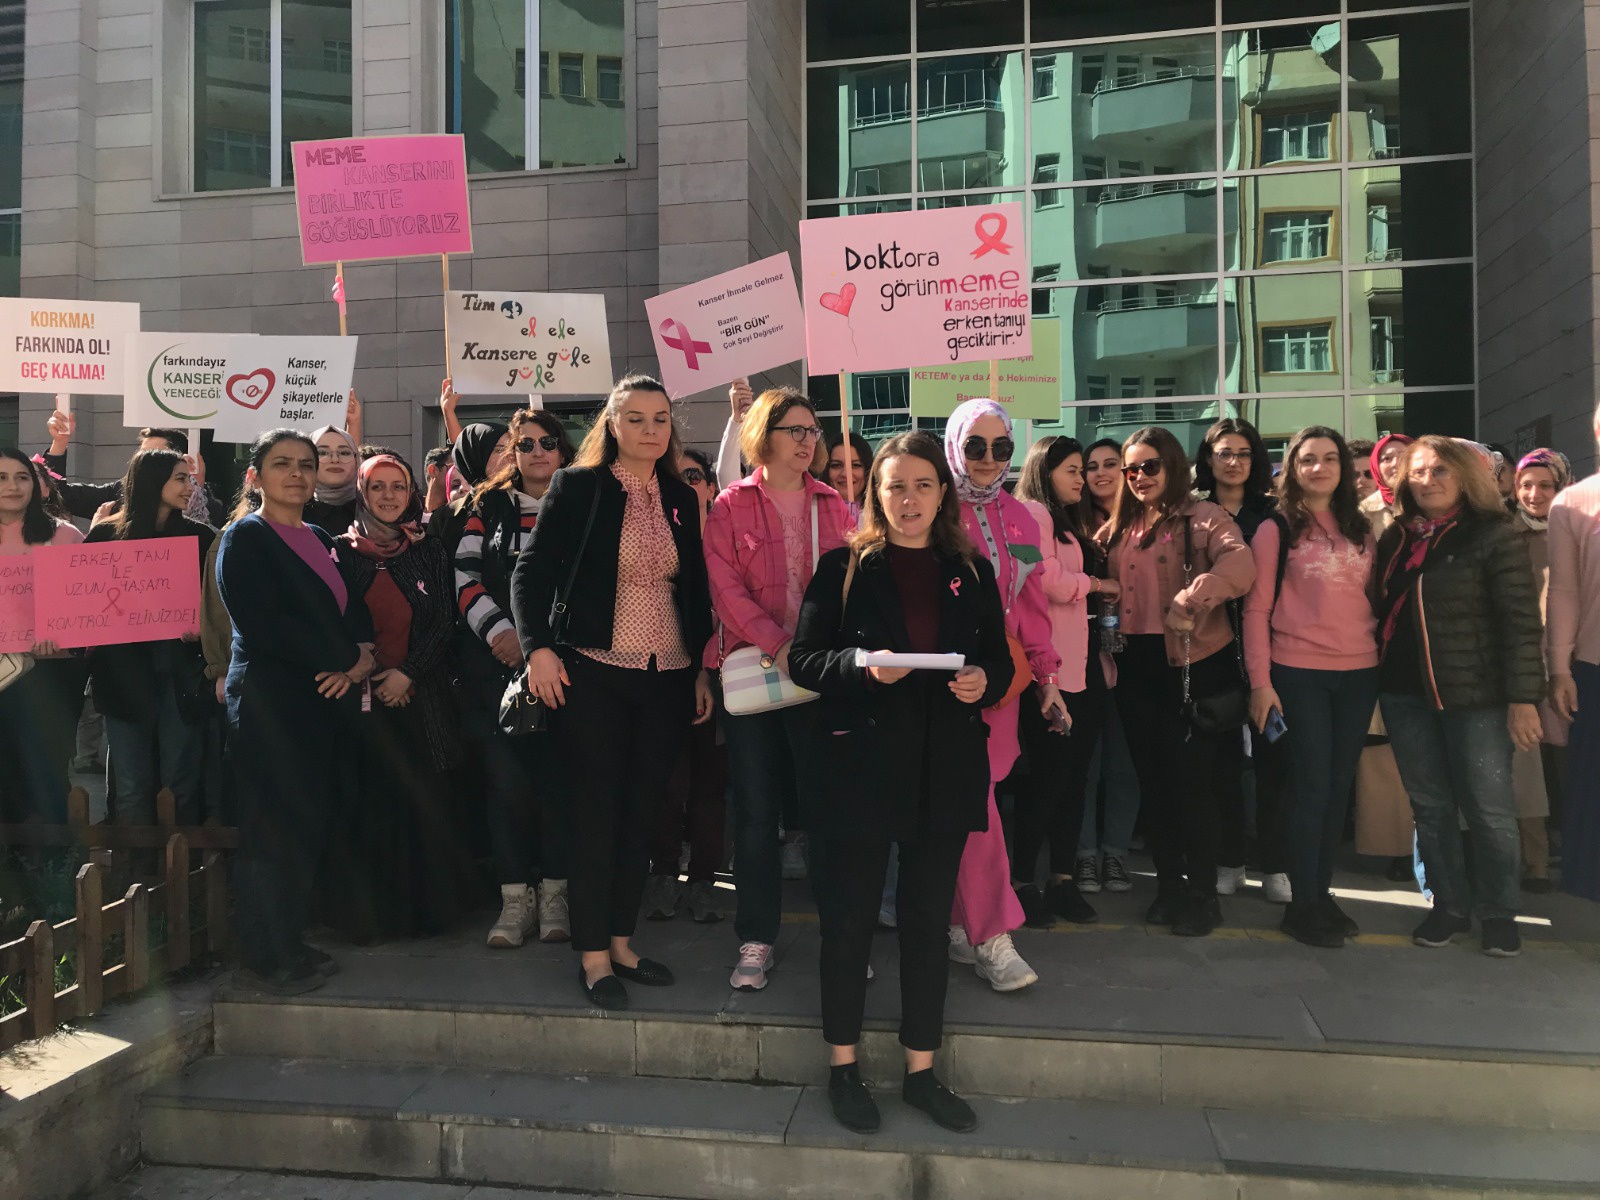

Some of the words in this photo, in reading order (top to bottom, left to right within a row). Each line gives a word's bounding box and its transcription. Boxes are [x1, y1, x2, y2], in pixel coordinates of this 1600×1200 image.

[305, 145, 366, 167] MEME
[307, 188, 403, 215] BİRLİKTE
[845, 241, 940, 271] Doktora
[698, 293, 726, 307] Kanser
[726, 284, 753, 298] İhmale
[754, 273, 784, 288] Gelmez
[462, 293, 495, 311] Tüm
[30, 310, 95, 329] KORKMA!
[717, 315, 739, 327] Bazen
[943, 314, 992, 331] erken
[993, 313, 1026, 337] tanıyı
[15, 336, 85, 354] FARKINDA
[88, 338, 110, 355] OL!
[461, 342, 538, 361] Kansere
[723, 339, 737, 350] Çok
[947, 331, 1015, 361] geciktirir.
[21, 361, 48, 381] GEÇ
[51, 362, 105, 380] KALMA!
[163, 355, 226, 369] farkındayız
[287, 357, 327, 371] Kanser,
[285, 373, 317, 388] küçük
[959, 374, 970, 382] ya
[973, 372, 984, 381] da
[1006, 373, 1057, 383] Hekiminize
[282, 391, 343, 405] şikayetlerle
[279, 407, 314, 421] başlar.
[69, 551, 122, 568] ERKEN
[135, 549, 170, 563] TANI
[111, 564, 133, 579] İLE
[65, 582, 106, 596] UZUN
[47, 614, 112, 631] KONTROL
